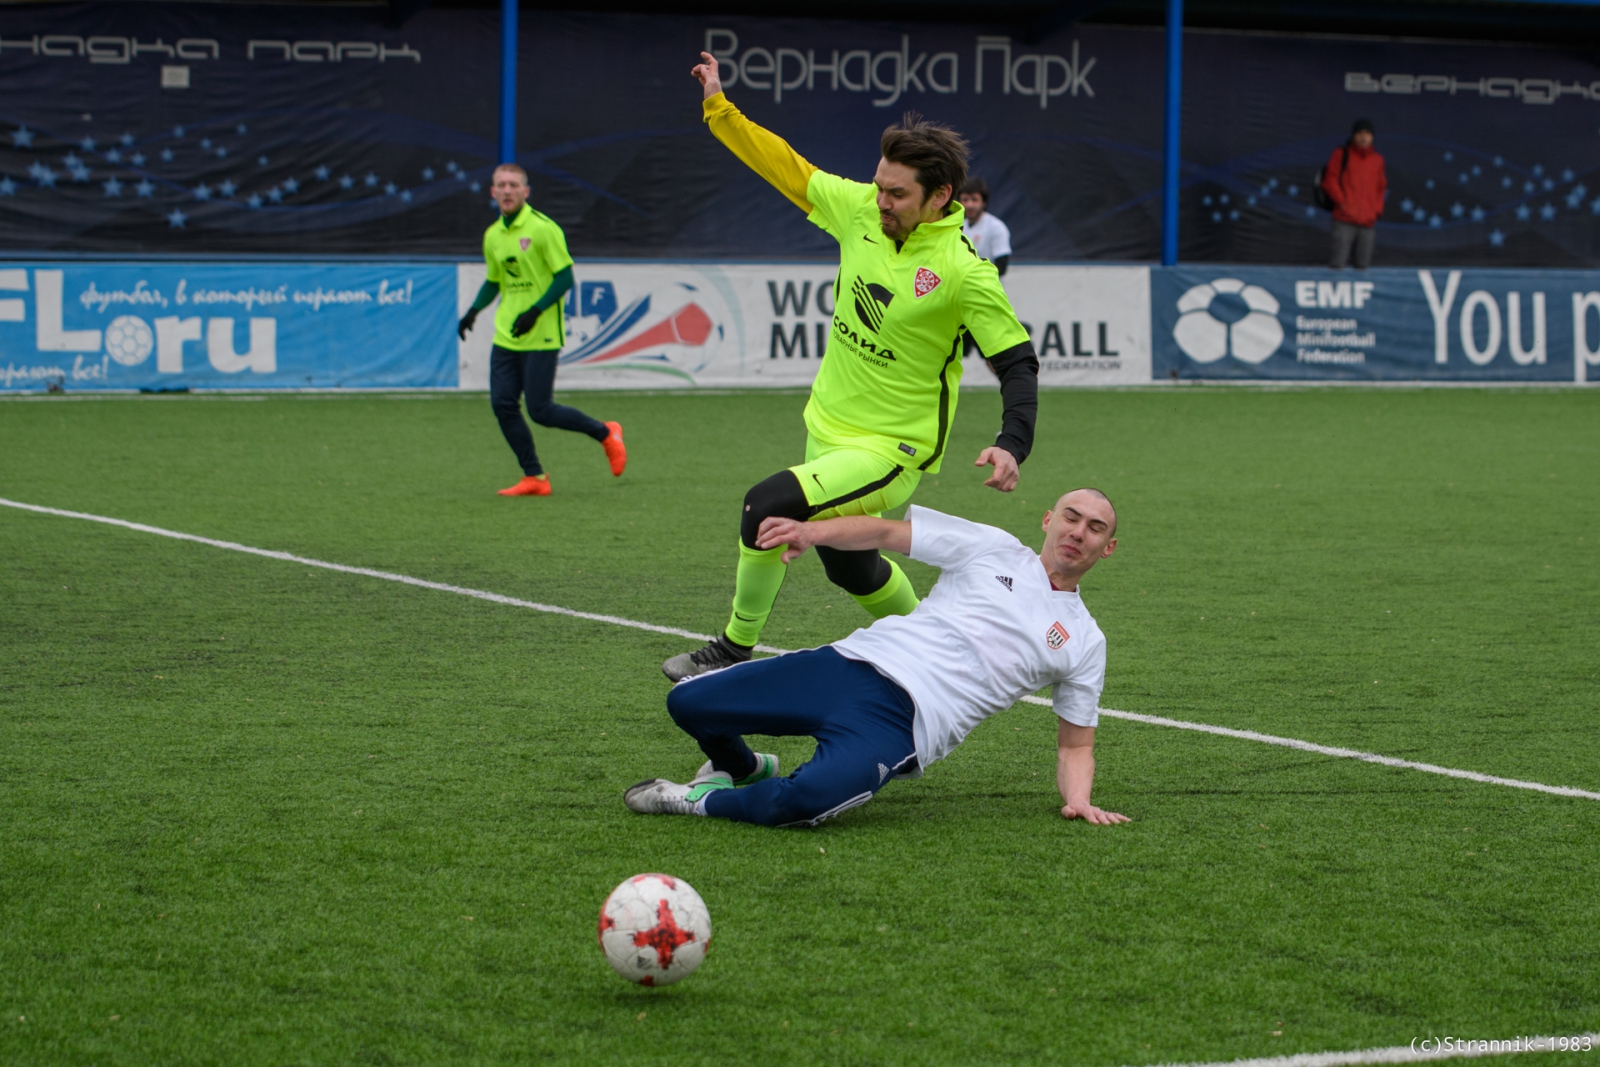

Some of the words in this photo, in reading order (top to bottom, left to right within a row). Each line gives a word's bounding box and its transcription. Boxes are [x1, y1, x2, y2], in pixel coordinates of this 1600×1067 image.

[975, 35, 1097, 110] Парк
[1295, 280, 1375, 309] EMF
[1296, 315, 1358, 332] European
[1418, 269, 1547, 366] You
[833, 315, 897, 361] СОЛИД
[1019, 321, 1120, 358] ALL
[1296, 331, 1376, 347] Minifootball
[858, 351, 889, 369] РЫНКИ
[1296, 348, 1366, 364] Federation
